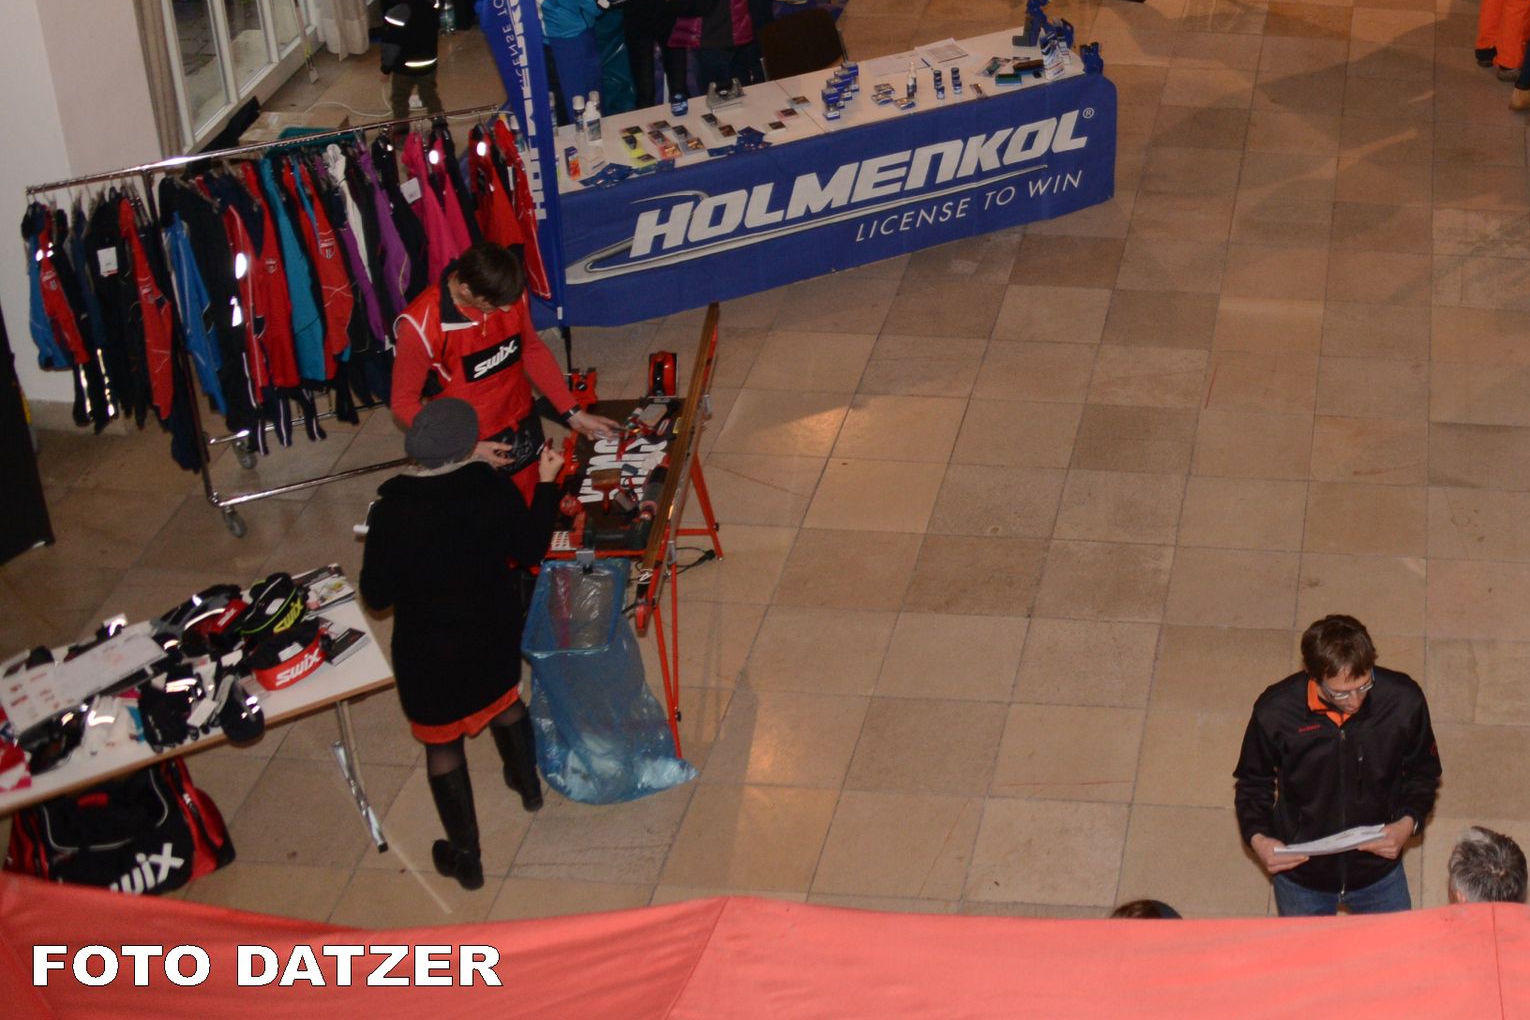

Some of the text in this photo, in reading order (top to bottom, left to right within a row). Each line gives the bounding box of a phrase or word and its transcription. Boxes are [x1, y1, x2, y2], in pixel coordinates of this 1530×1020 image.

[629, 111, 1088, 259] HOLMENKOL
[855, 170, 1082, 243] LICENSE TO WIN
